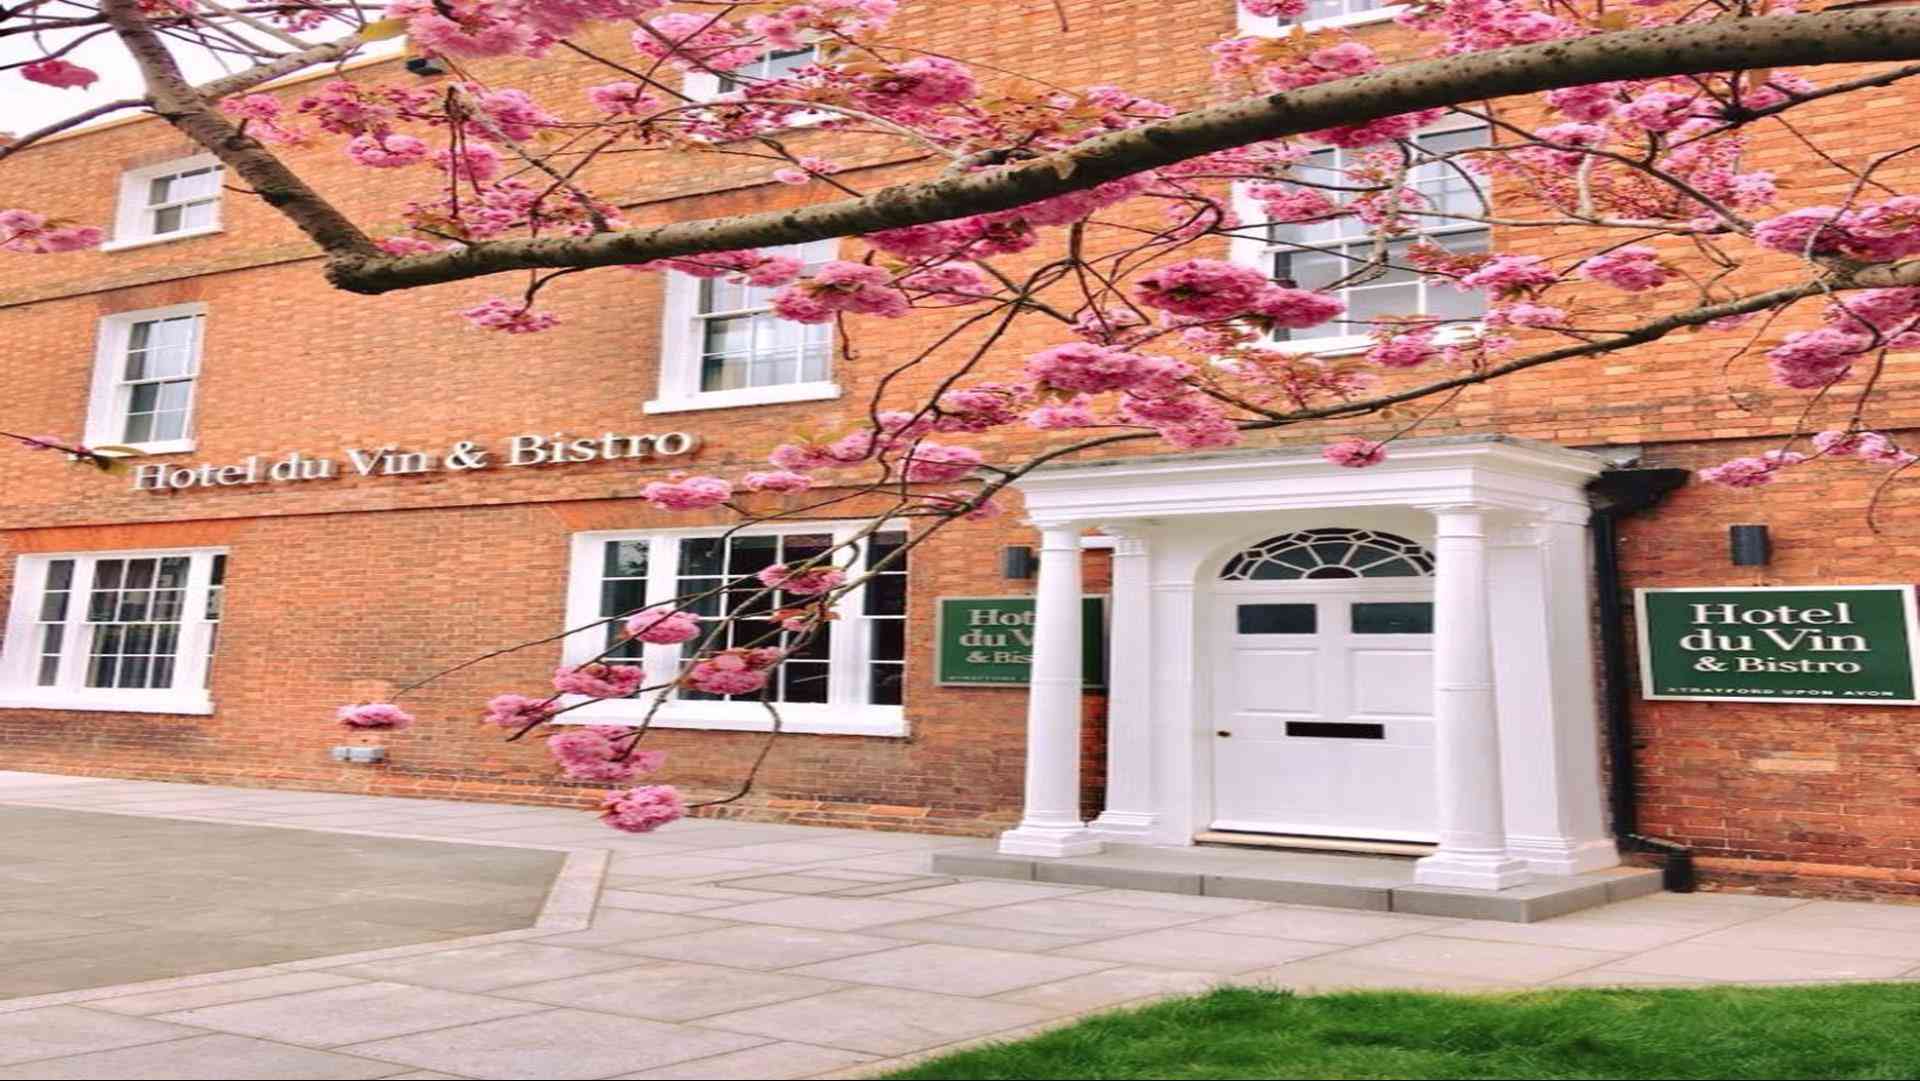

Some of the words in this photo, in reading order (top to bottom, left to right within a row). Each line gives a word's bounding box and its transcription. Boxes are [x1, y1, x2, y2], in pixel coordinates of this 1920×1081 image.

[131, 455, 257, 491] Hotel
[270, 453, 331, 481] du
[345, 442, 426, 476] Vin
[445, 440, 489, 470] &
[503, 431, 693, 467] Bistro
[967, 608, 1037, 626] Hot
[1688, 602, 1854, 625] Hotel
[959, 629, 1007, 647] du
[1007, 629, 1034, 647] V
[1679, 629, 1755, 652] du
[1759, 628, 1872, 652] Vin
[965, 651, 991, 664] &
[993, 651, 1034, 664] Bis
[1693, 656, 1729, 673] &
[1735, 656, 1862, 674] Bistro
